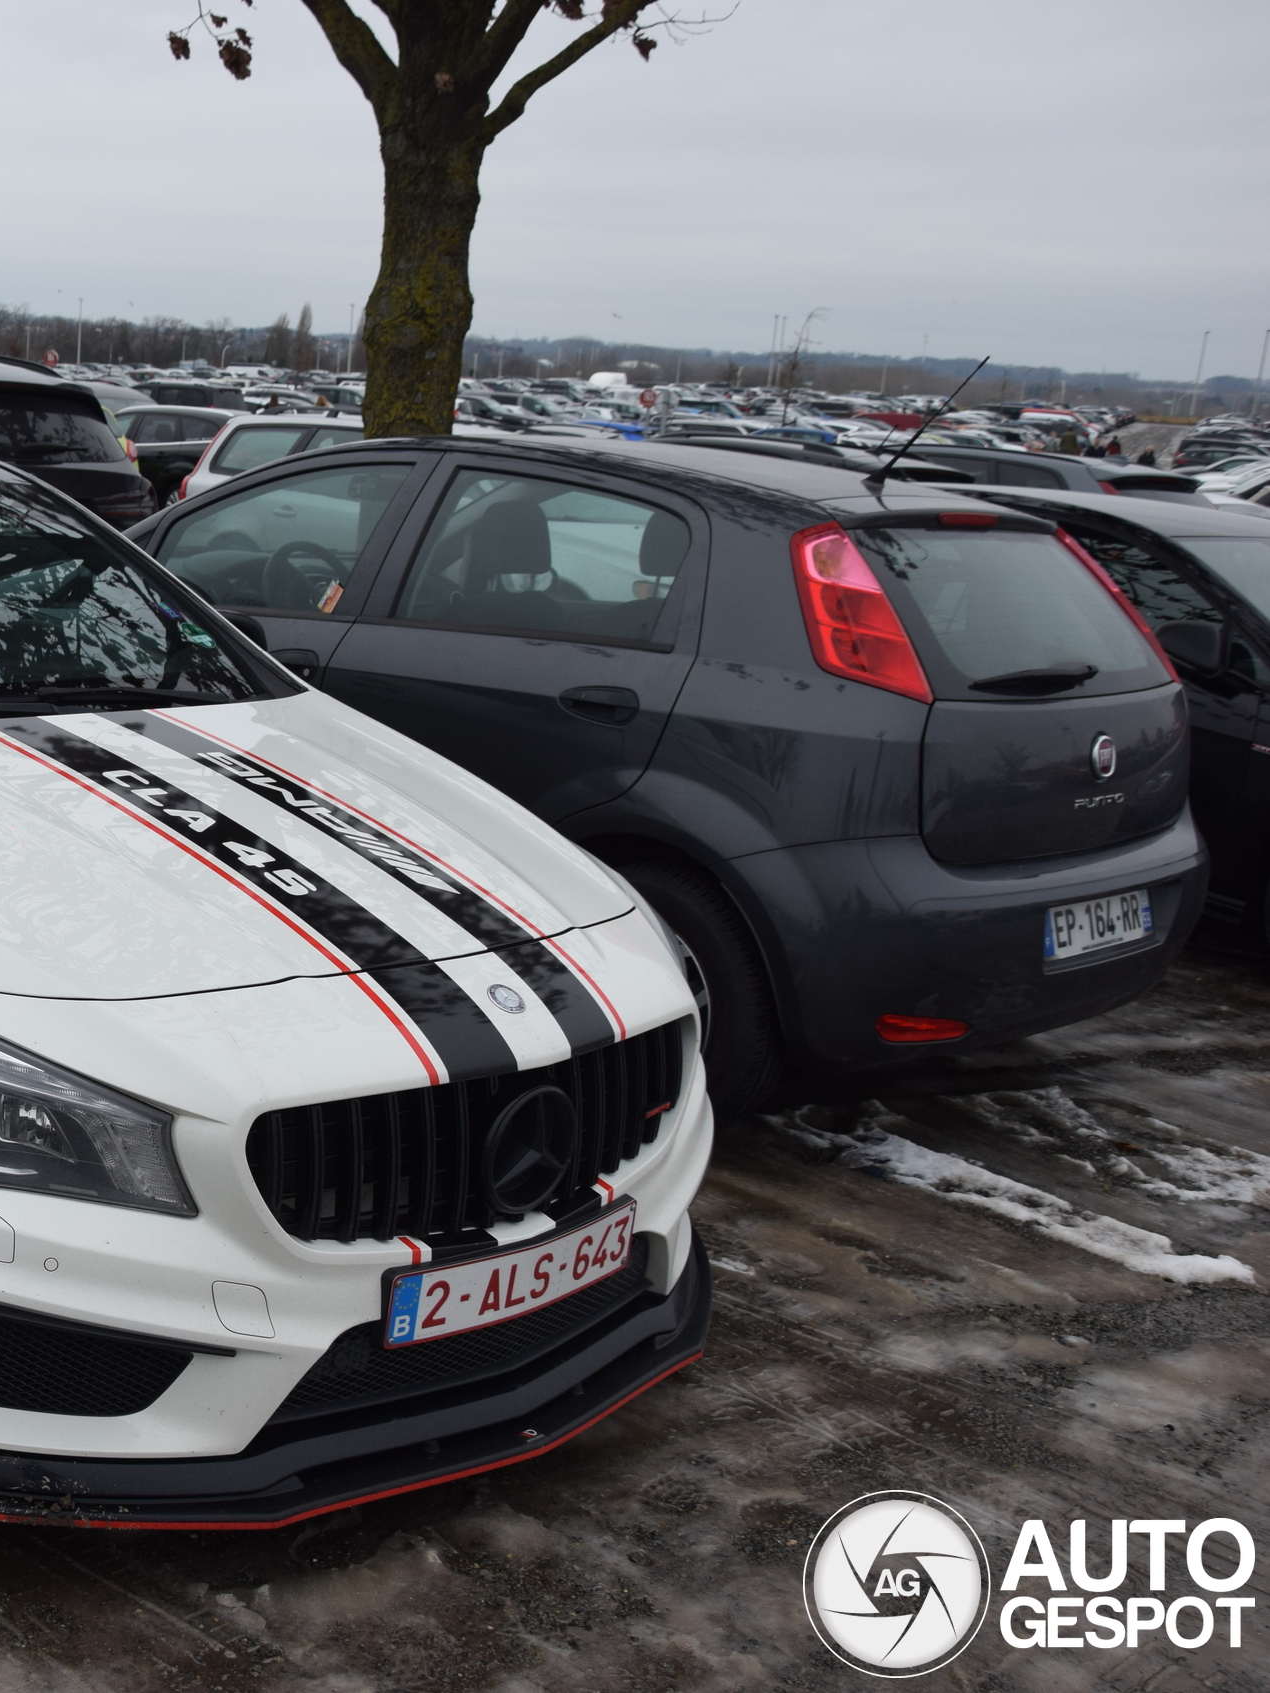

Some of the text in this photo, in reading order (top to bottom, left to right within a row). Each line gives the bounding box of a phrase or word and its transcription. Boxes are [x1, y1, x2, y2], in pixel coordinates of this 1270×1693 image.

[102, 770, 318, 896] CLA 45
[1053, 894, 1142, 949] EP-164-RR
[421, 1215, 630, 1329] 2-ALS-643
[393, 1315, 411, 1338] B
